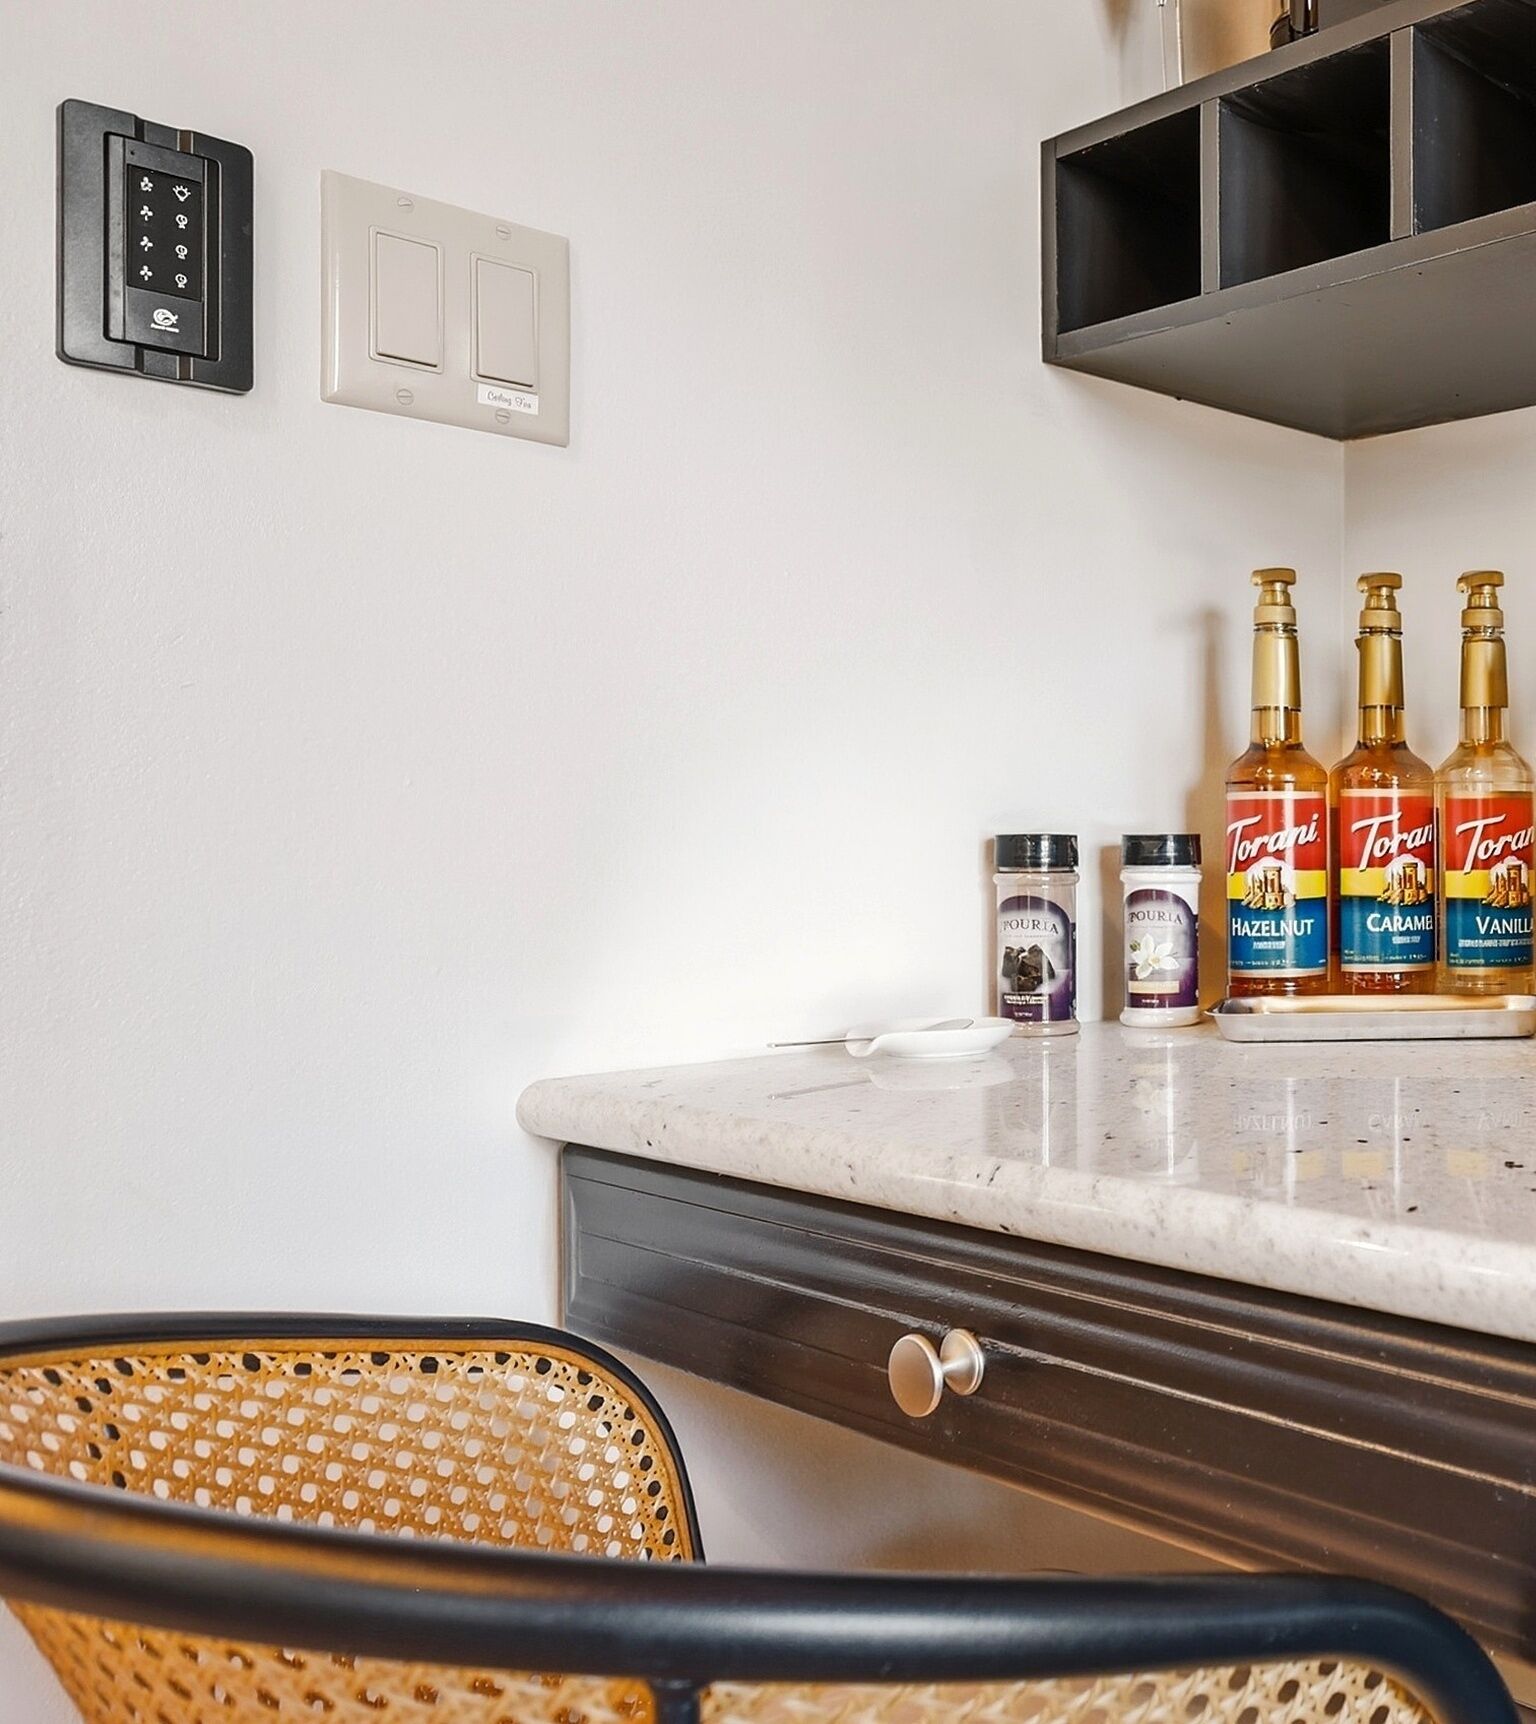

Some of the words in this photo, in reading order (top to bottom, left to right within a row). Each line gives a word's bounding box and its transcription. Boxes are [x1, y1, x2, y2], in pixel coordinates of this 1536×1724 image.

[1226, 812, 1320, 876] Torani
[1003, 918, 1059, 935] POURIA
[1128, 910, 1183, 925] POURIA
[1231, 917, 1315, 938] HAZELNUT
